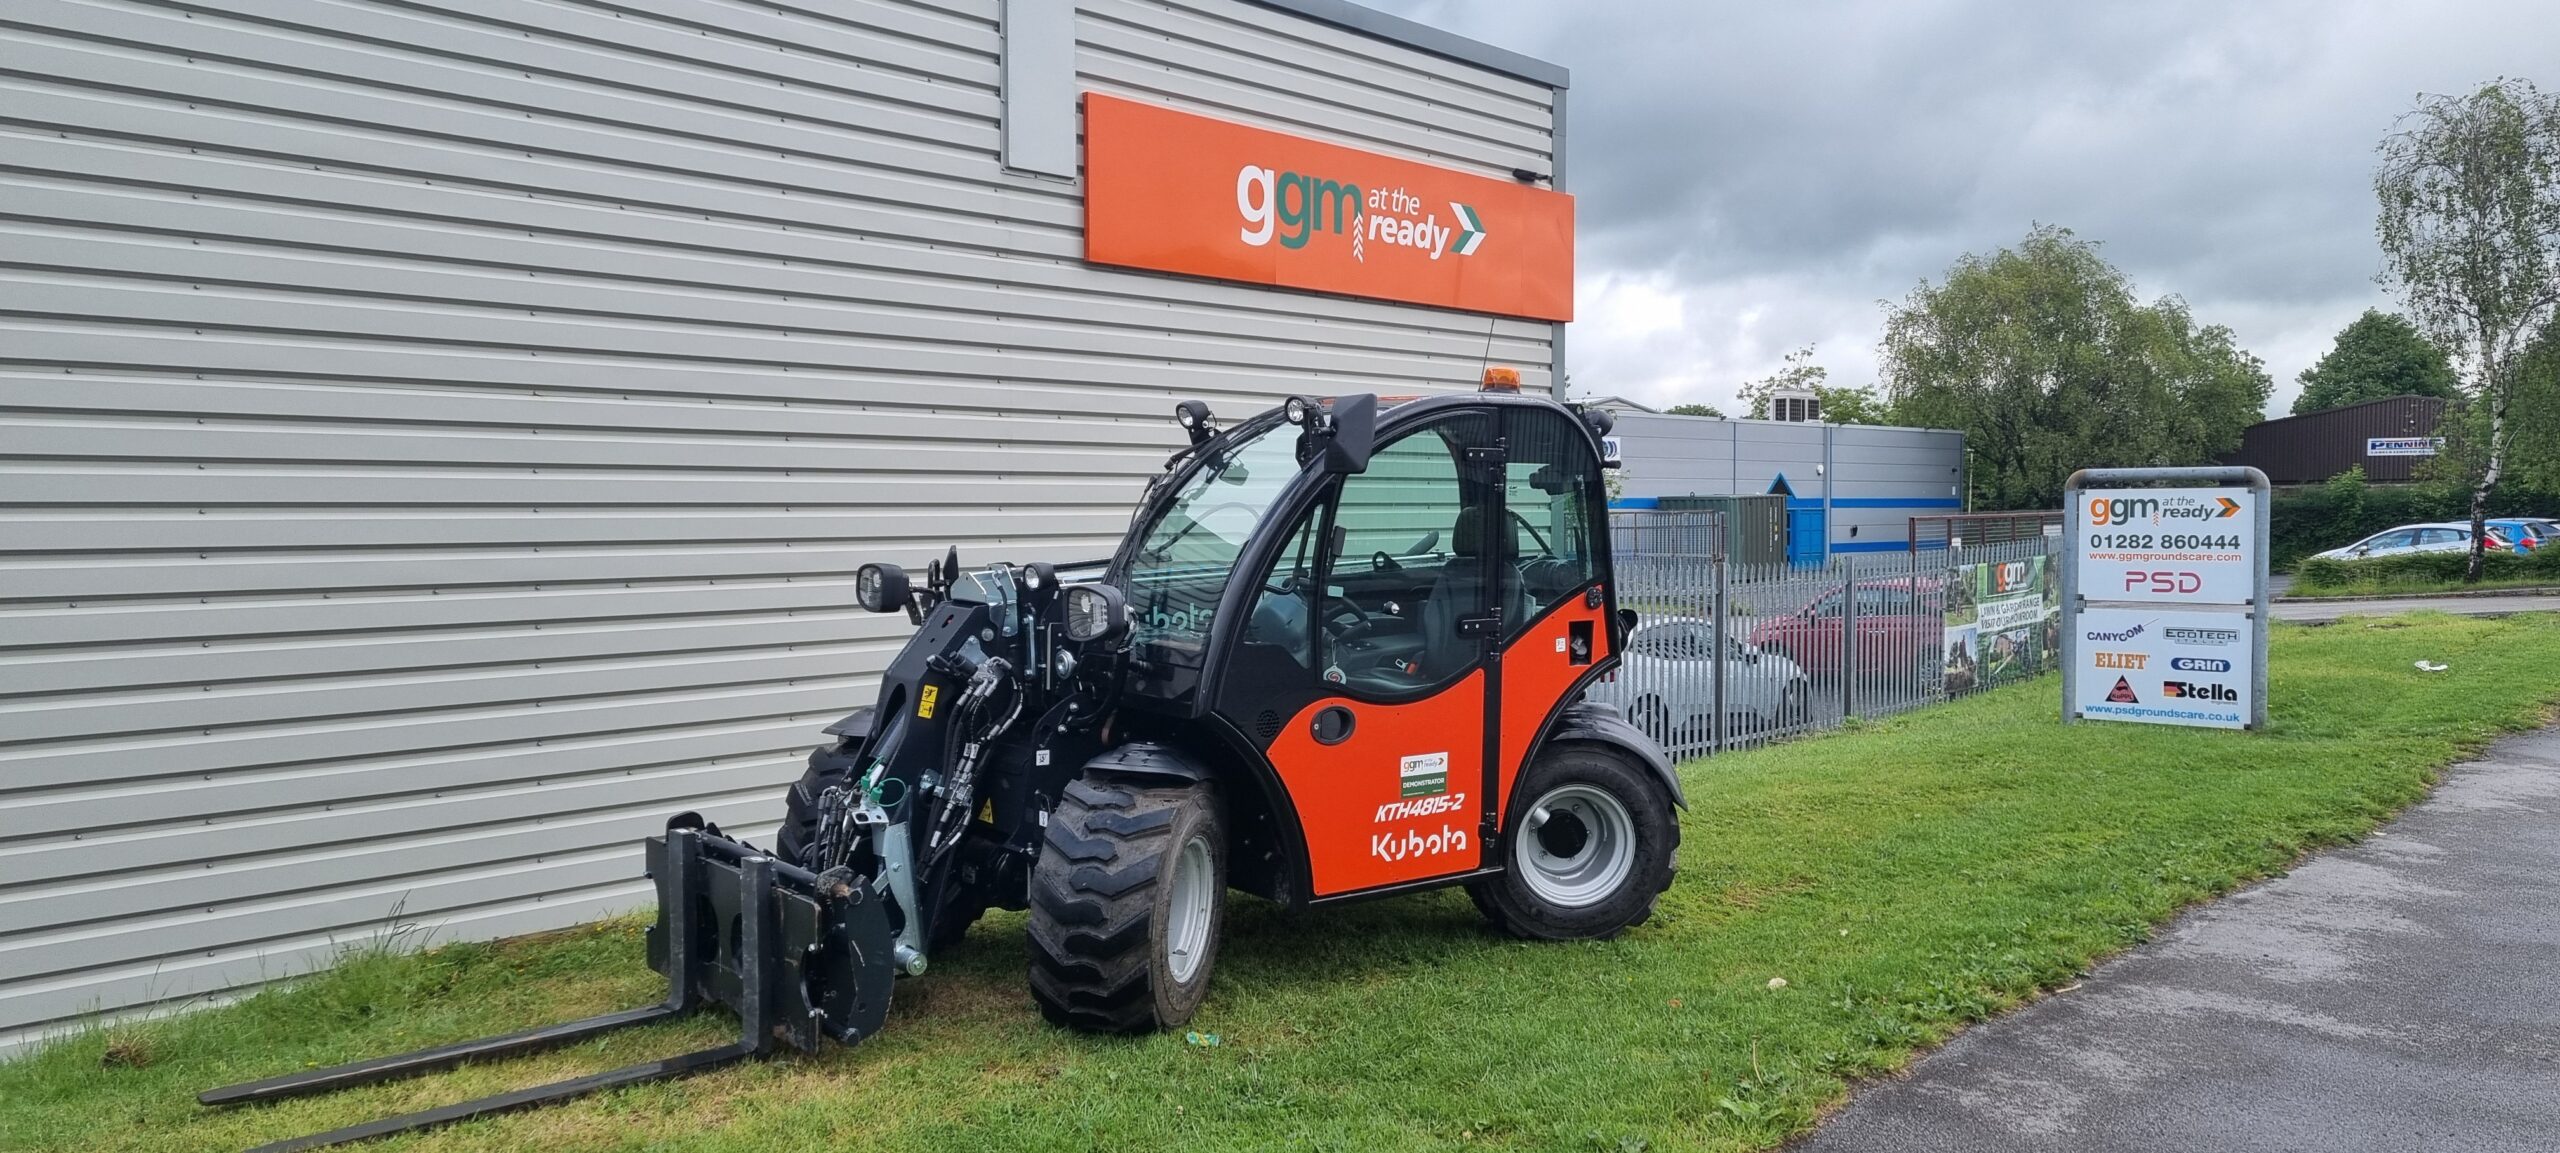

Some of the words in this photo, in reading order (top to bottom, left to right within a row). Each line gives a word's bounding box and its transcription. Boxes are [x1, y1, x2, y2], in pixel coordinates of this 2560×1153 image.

[1237, 165, 1363, 249] ggm
[1369, 188, 1388, 210] at
[1391, 187, 1420, 215] the
[1368, 214, 1450, 260] ready
[2090, 497, 2159, 525] ggm
[2162, 497, 2175, 506] at
[2177, 496, 2195, 506] the
[2162, 504, 2215, 522] ready
[2090, 534, 2153, 549] 01282
[2160, 534, 2240, 550] 860444
[2089, 552, 2241, 563] www.ggmgroundscare.com
[2125, 571, 2201, 594] PSD
[2087, 624, 2145, 642] CANYCOM
[2095, 652, 2147, 669] ELIET
[2176, 682, 2238, 701] Stella
[2085, 705, 2240, 722] www.psdgroundscare.co.uk
[1404, 760, 1423, 772] ggm
[1403, 778, 1445, 788] DEMONSTRATOR
[1374, 793, 1465, 823] KTH4815-2
[1372, 824, 1467, 862] Kubota
